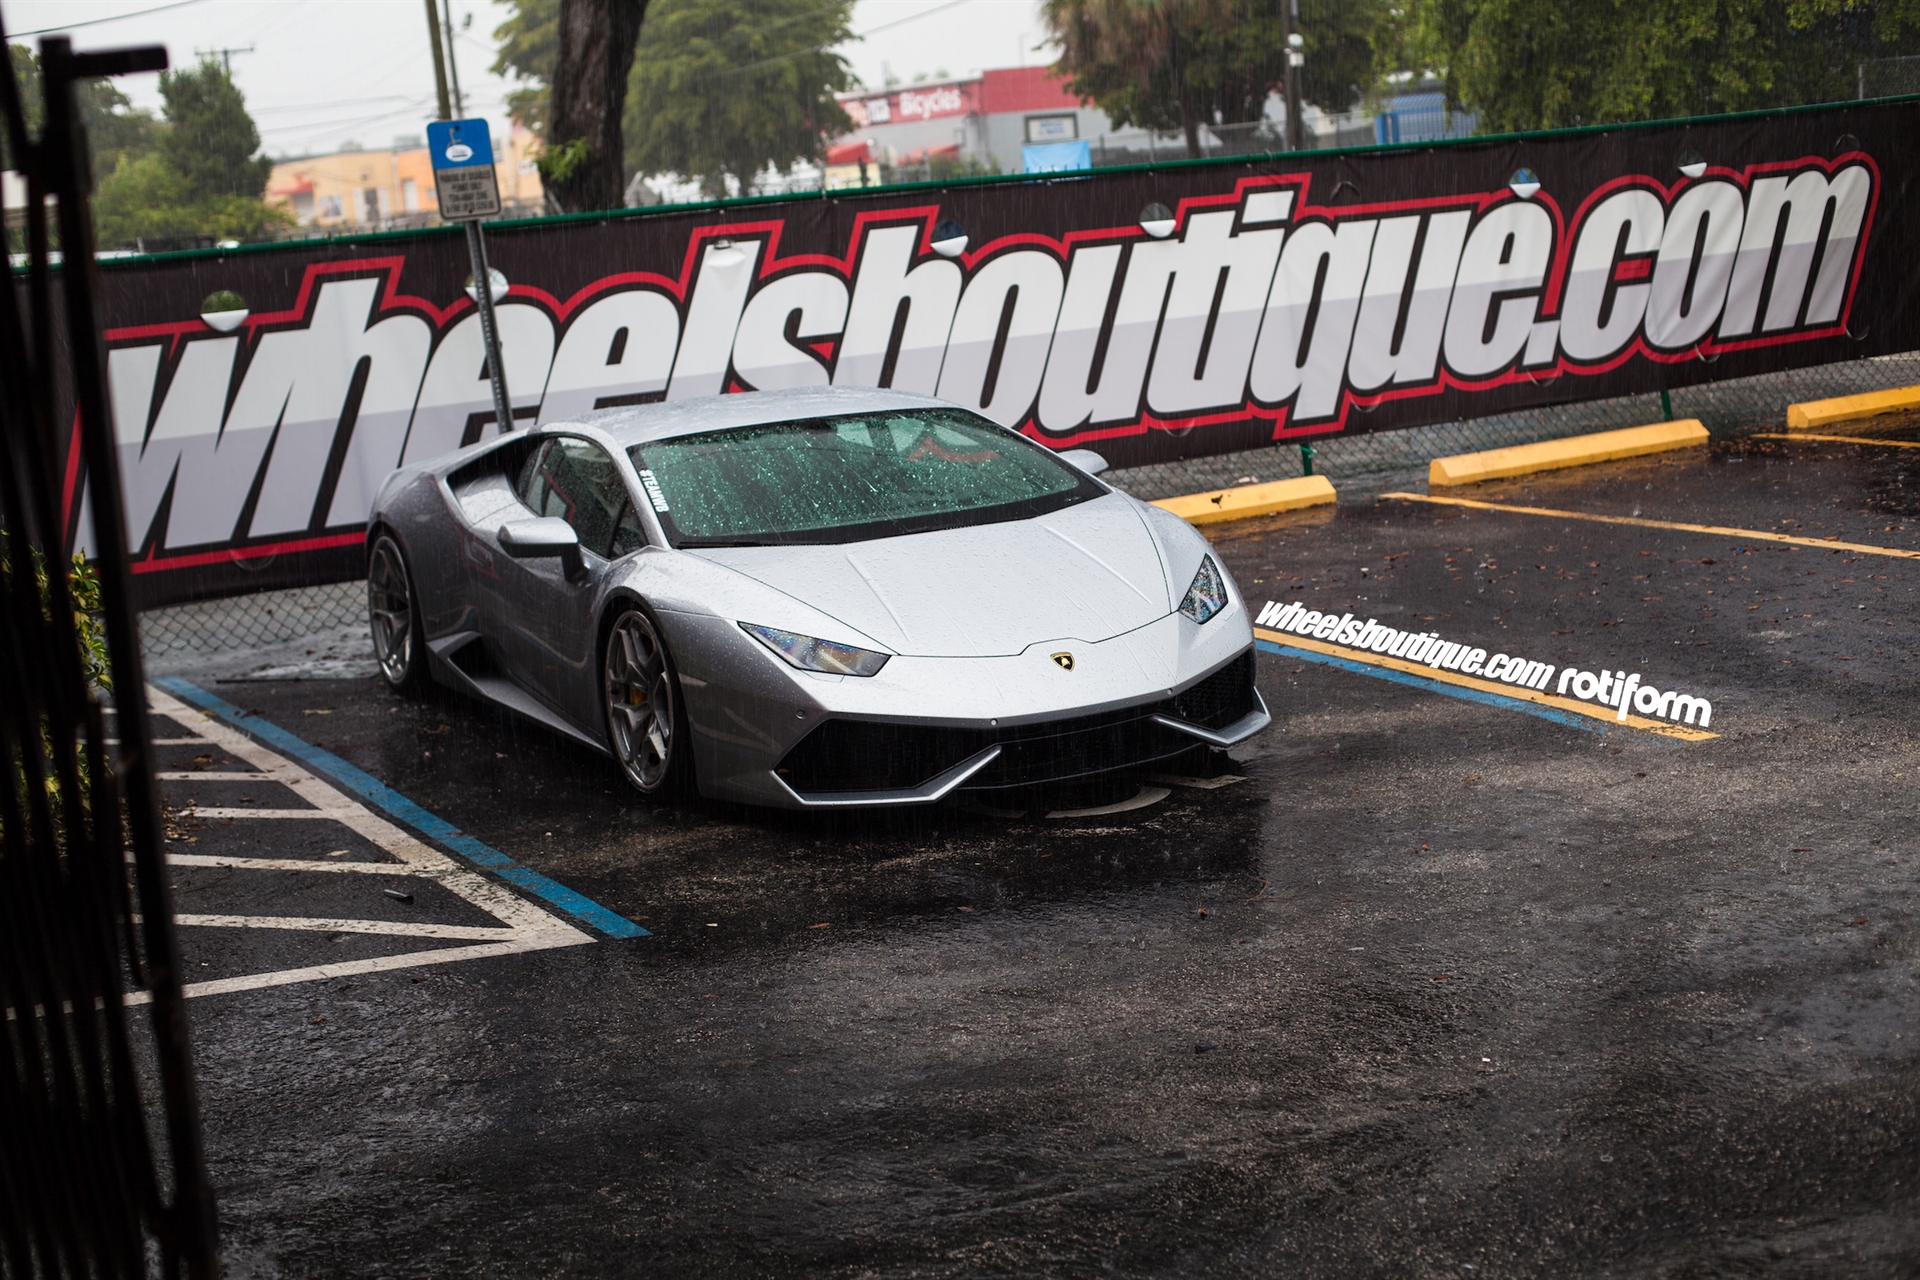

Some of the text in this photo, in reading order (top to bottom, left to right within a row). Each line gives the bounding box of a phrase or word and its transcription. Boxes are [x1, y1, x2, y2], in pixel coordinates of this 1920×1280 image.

[899, 87, 962, 121] Bicycles
[74, 166, 1870, 560] wheelsboutique.com
[639, 469, 670, 513] #TEAMWB
